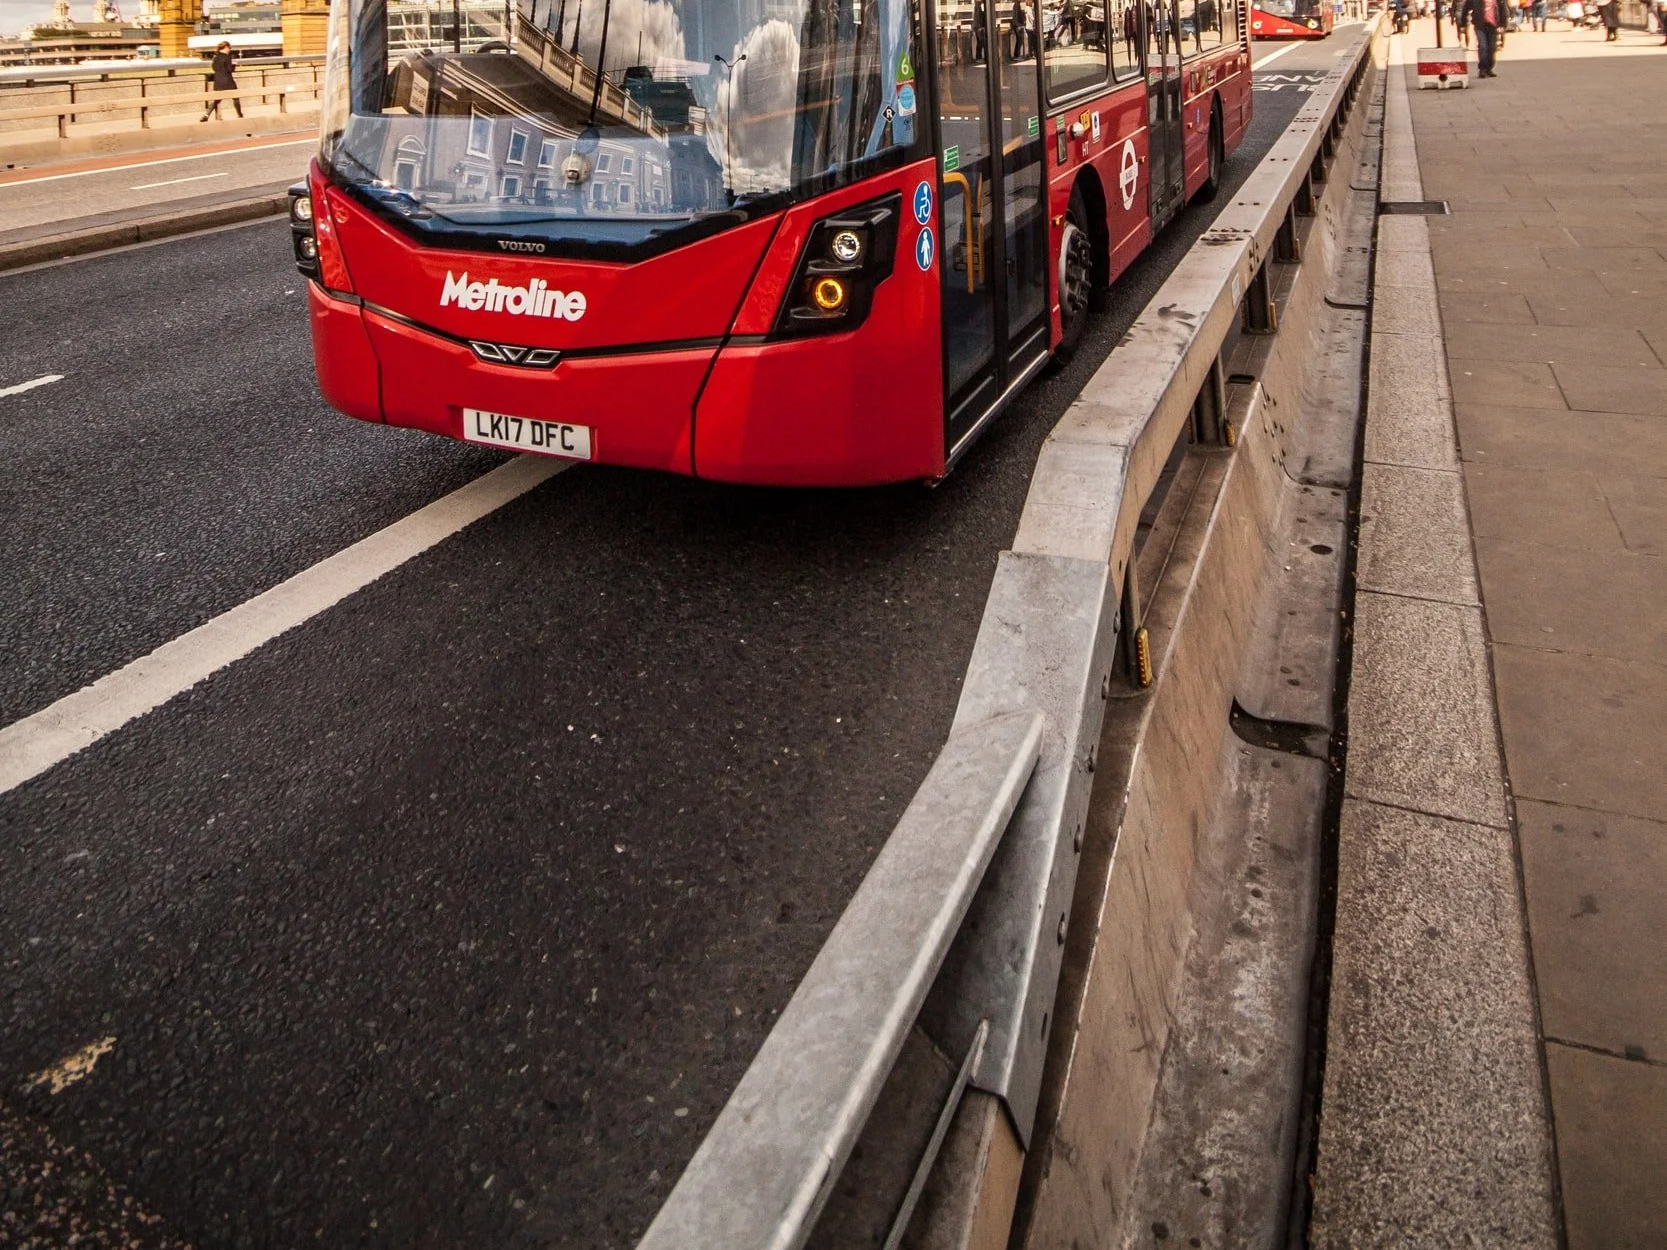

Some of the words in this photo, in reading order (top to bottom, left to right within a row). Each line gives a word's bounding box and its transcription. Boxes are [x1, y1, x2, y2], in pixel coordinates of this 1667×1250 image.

[901, 57, 909, 75] 6
[886, 108, 893, 118] R
[498, 240, 546, 253] VOLVO
[439, 270, 587, 322] Metroline
[476, 412, 523, 442] LK17
[530, 420, 575, 451] DFC
